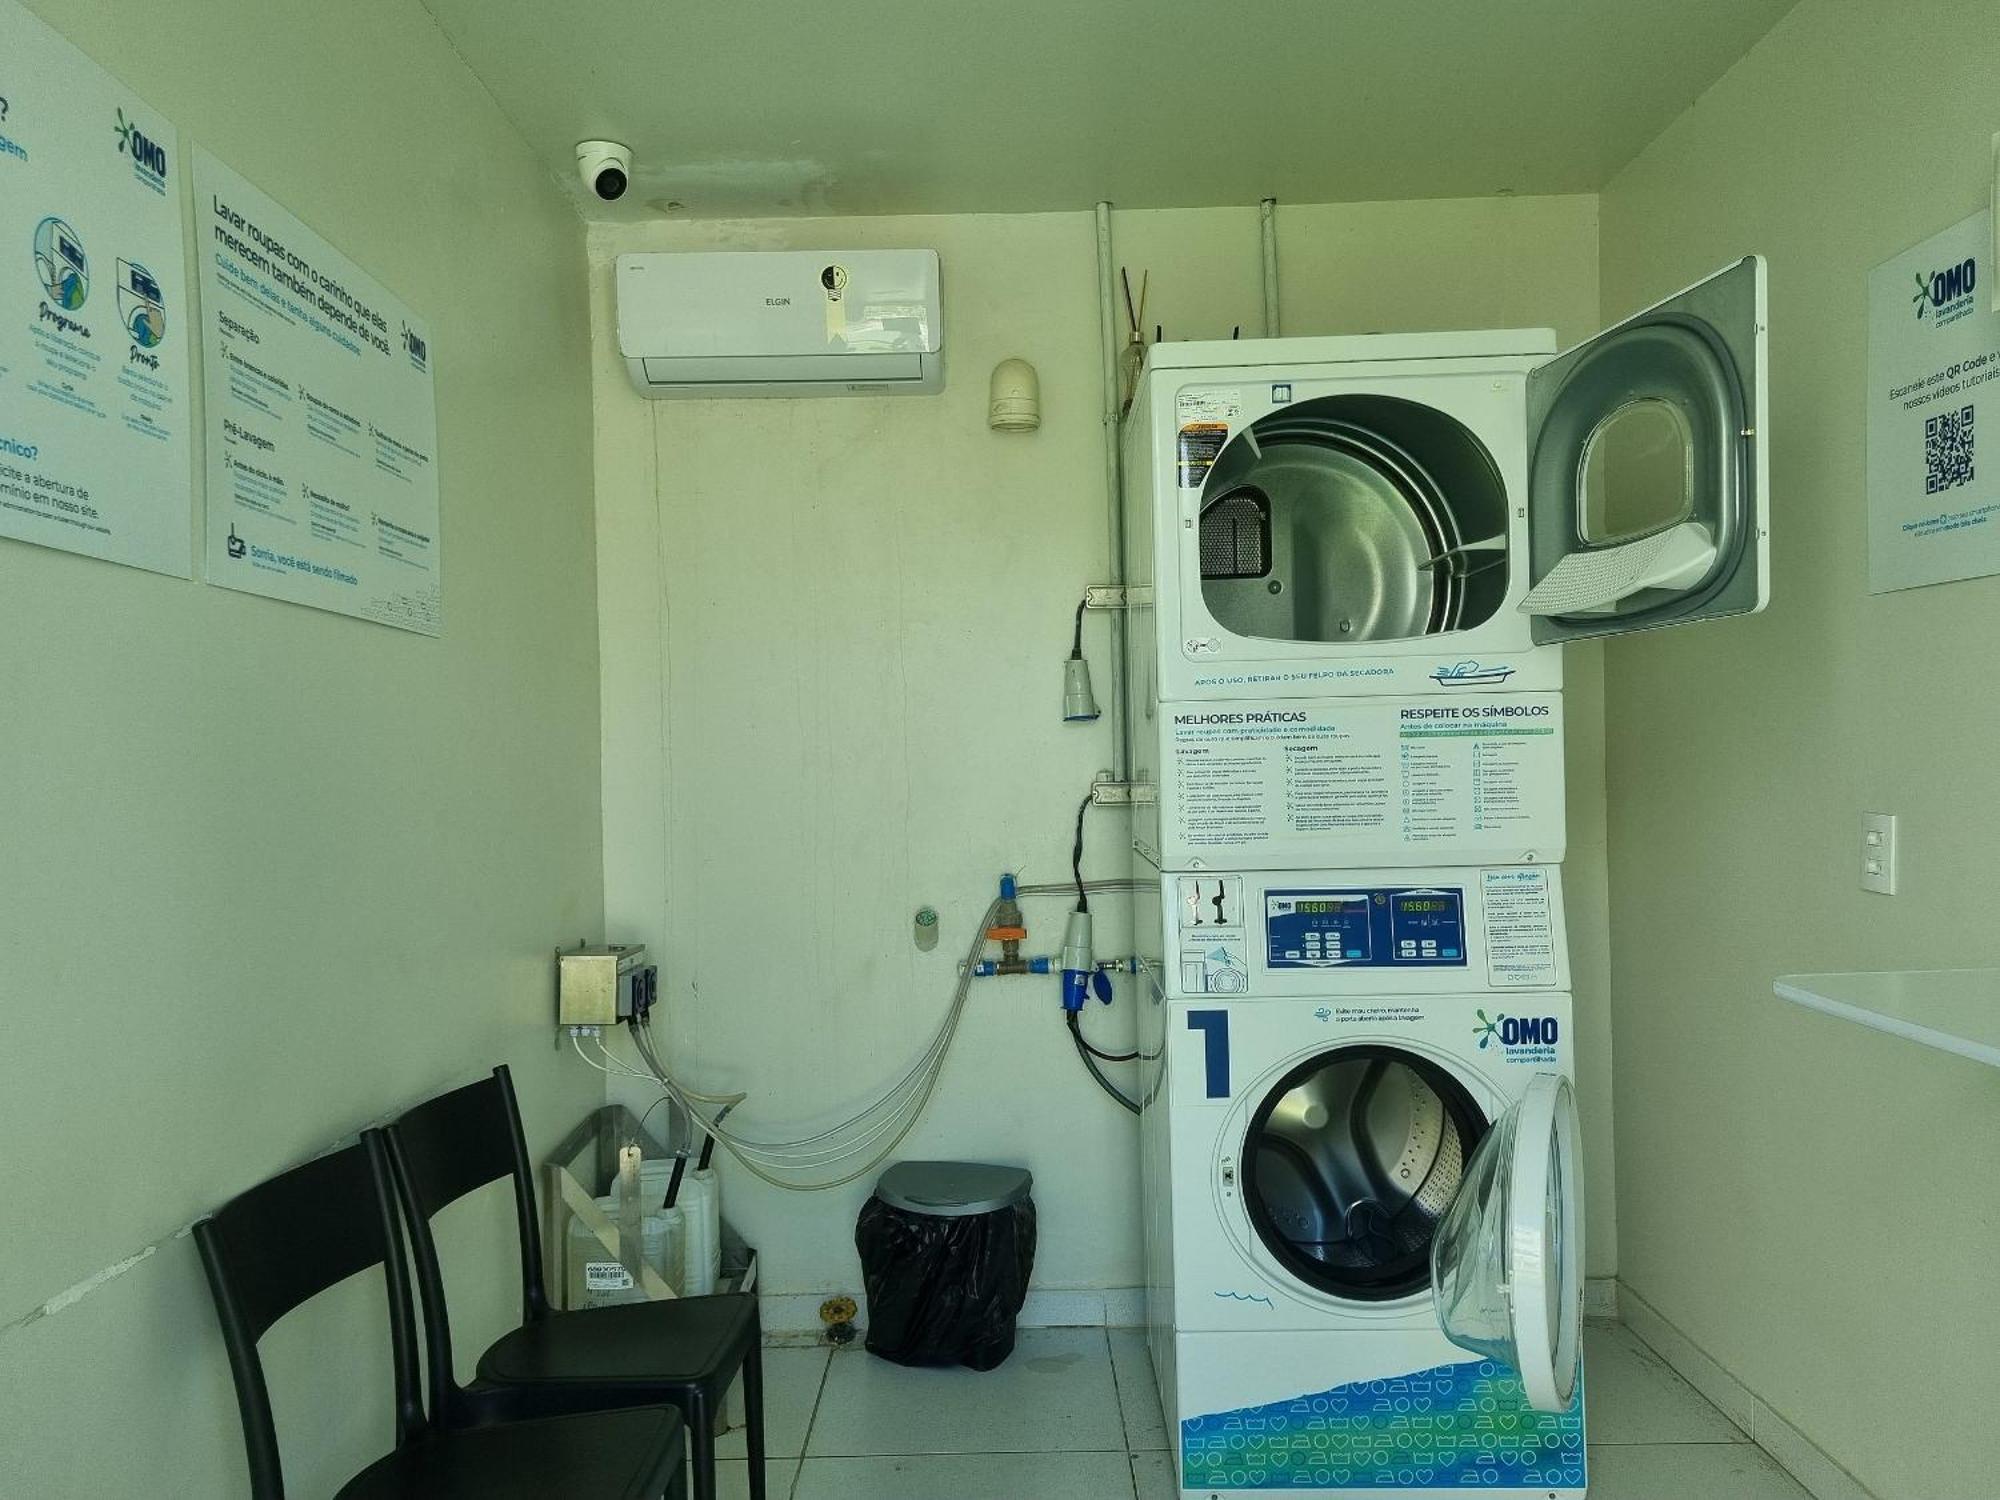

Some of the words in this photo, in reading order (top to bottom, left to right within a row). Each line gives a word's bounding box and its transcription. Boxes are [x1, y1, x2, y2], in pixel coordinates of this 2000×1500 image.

[132, 130, 166, 178] OMO
[213, 194, 246, 232] Lavar
[247, 223, 286, 260] roupas
[287, 252, 310, 279] com
[311, 269, 318, 284] o
[319, 275, 353, 308] carinho
[354, 300, 370, 321] que
[371, 312, 388, 333] elas
[215, 225, 270, 275] merecem
[271, 262, 316, 306] também
[318, 294, 358, 334] depende
[358, 322, 370, 341] de
[1933, 257, 1976, 308] OMO
[766, 298, 791, 306] ELGIN
[219, 310, 260, 344] Separação
[1946, 363, 1961, 379] QR
[1962, 354, 1988, 372] Code
[1989, 352, 1996, 362] e
[1903, 394, 1932, 411] nossos
[1932, 383, 1961, 399] vídeos
[223, 418, 276, 453] Pré-Lavagem
[33, 474, 75, 497] abertura
[77, 487, 89, 501] de
[33, 492, 50, 506] em
[52, 497, 80, 514] nosso
[1174, 712, 1244, 725] MELHORES
[1246, 710, 1307, 724] PRÁTICAS
[1400, 708, 1460, 719] RESPEITE
[1462, 707, 1480, 718] OS
[1481, 704, 1549, 717] SÍMBOLOS
[1502, 1017, 1558, 1046] OMO
[1186, 1009, 1231, 1100] 1
[1506, 1046, 1556, 1055] lavanderia
